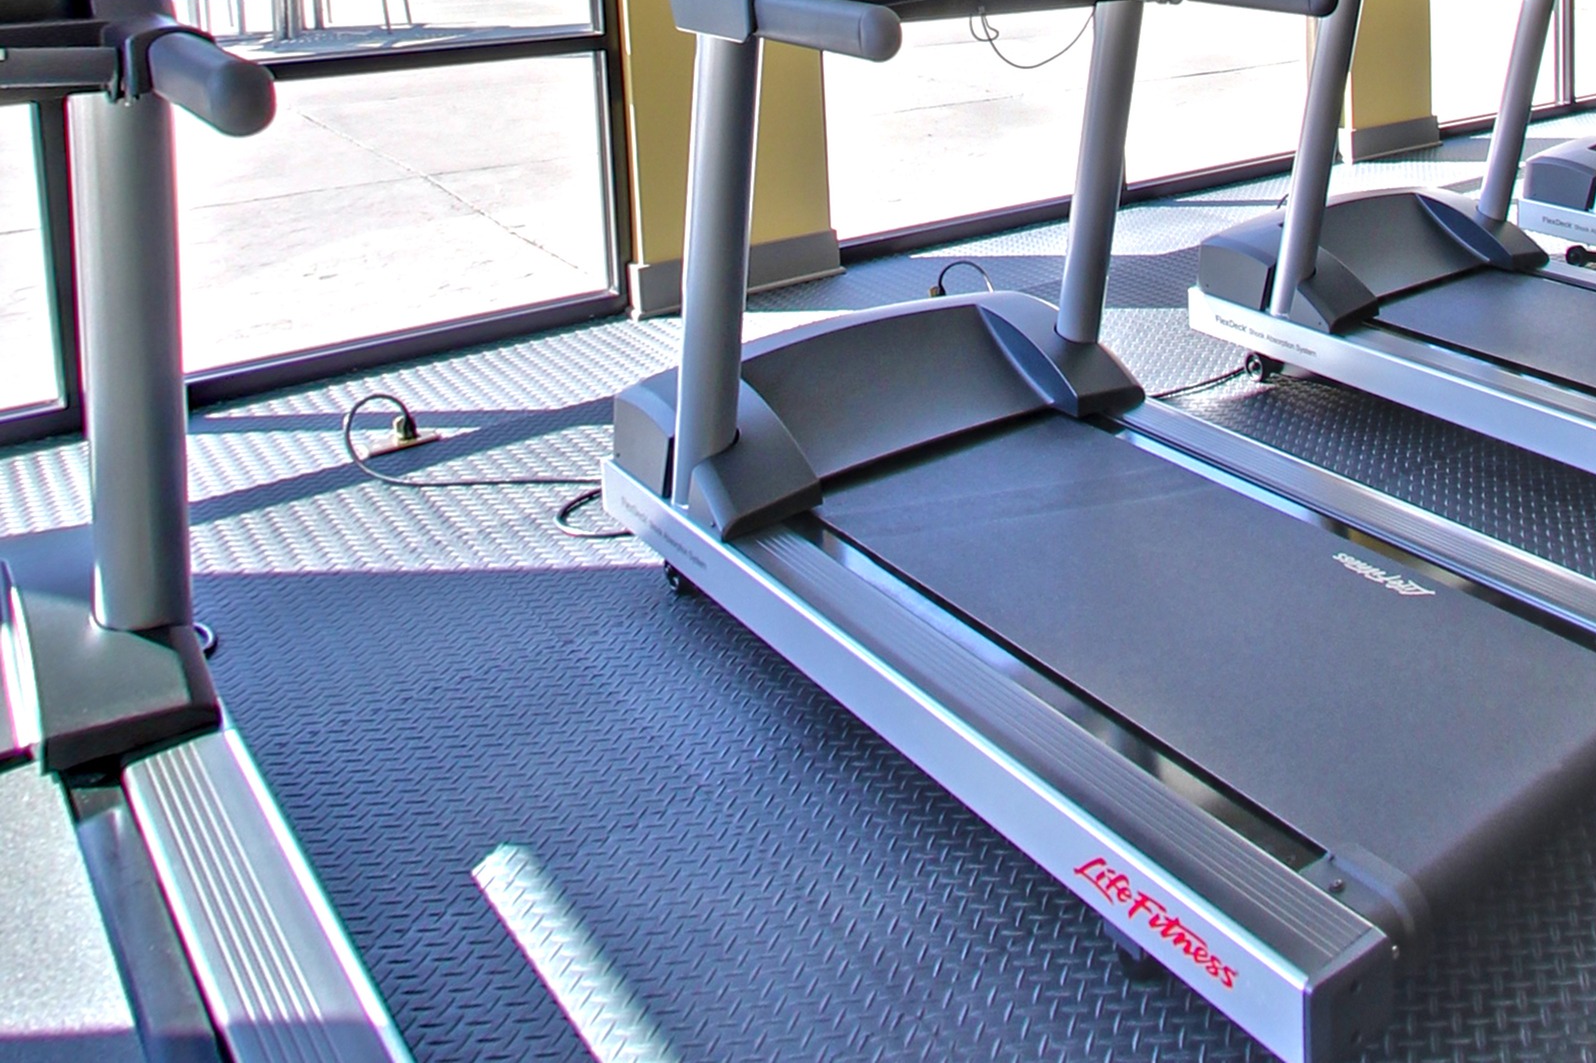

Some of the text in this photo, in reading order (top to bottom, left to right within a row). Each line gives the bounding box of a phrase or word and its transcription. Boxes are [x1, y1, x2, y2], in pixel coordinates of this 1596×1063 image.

[1215, 315, 1247, 332] FlexDeck
[1074, 857, 1238, 988] Life Fitness
